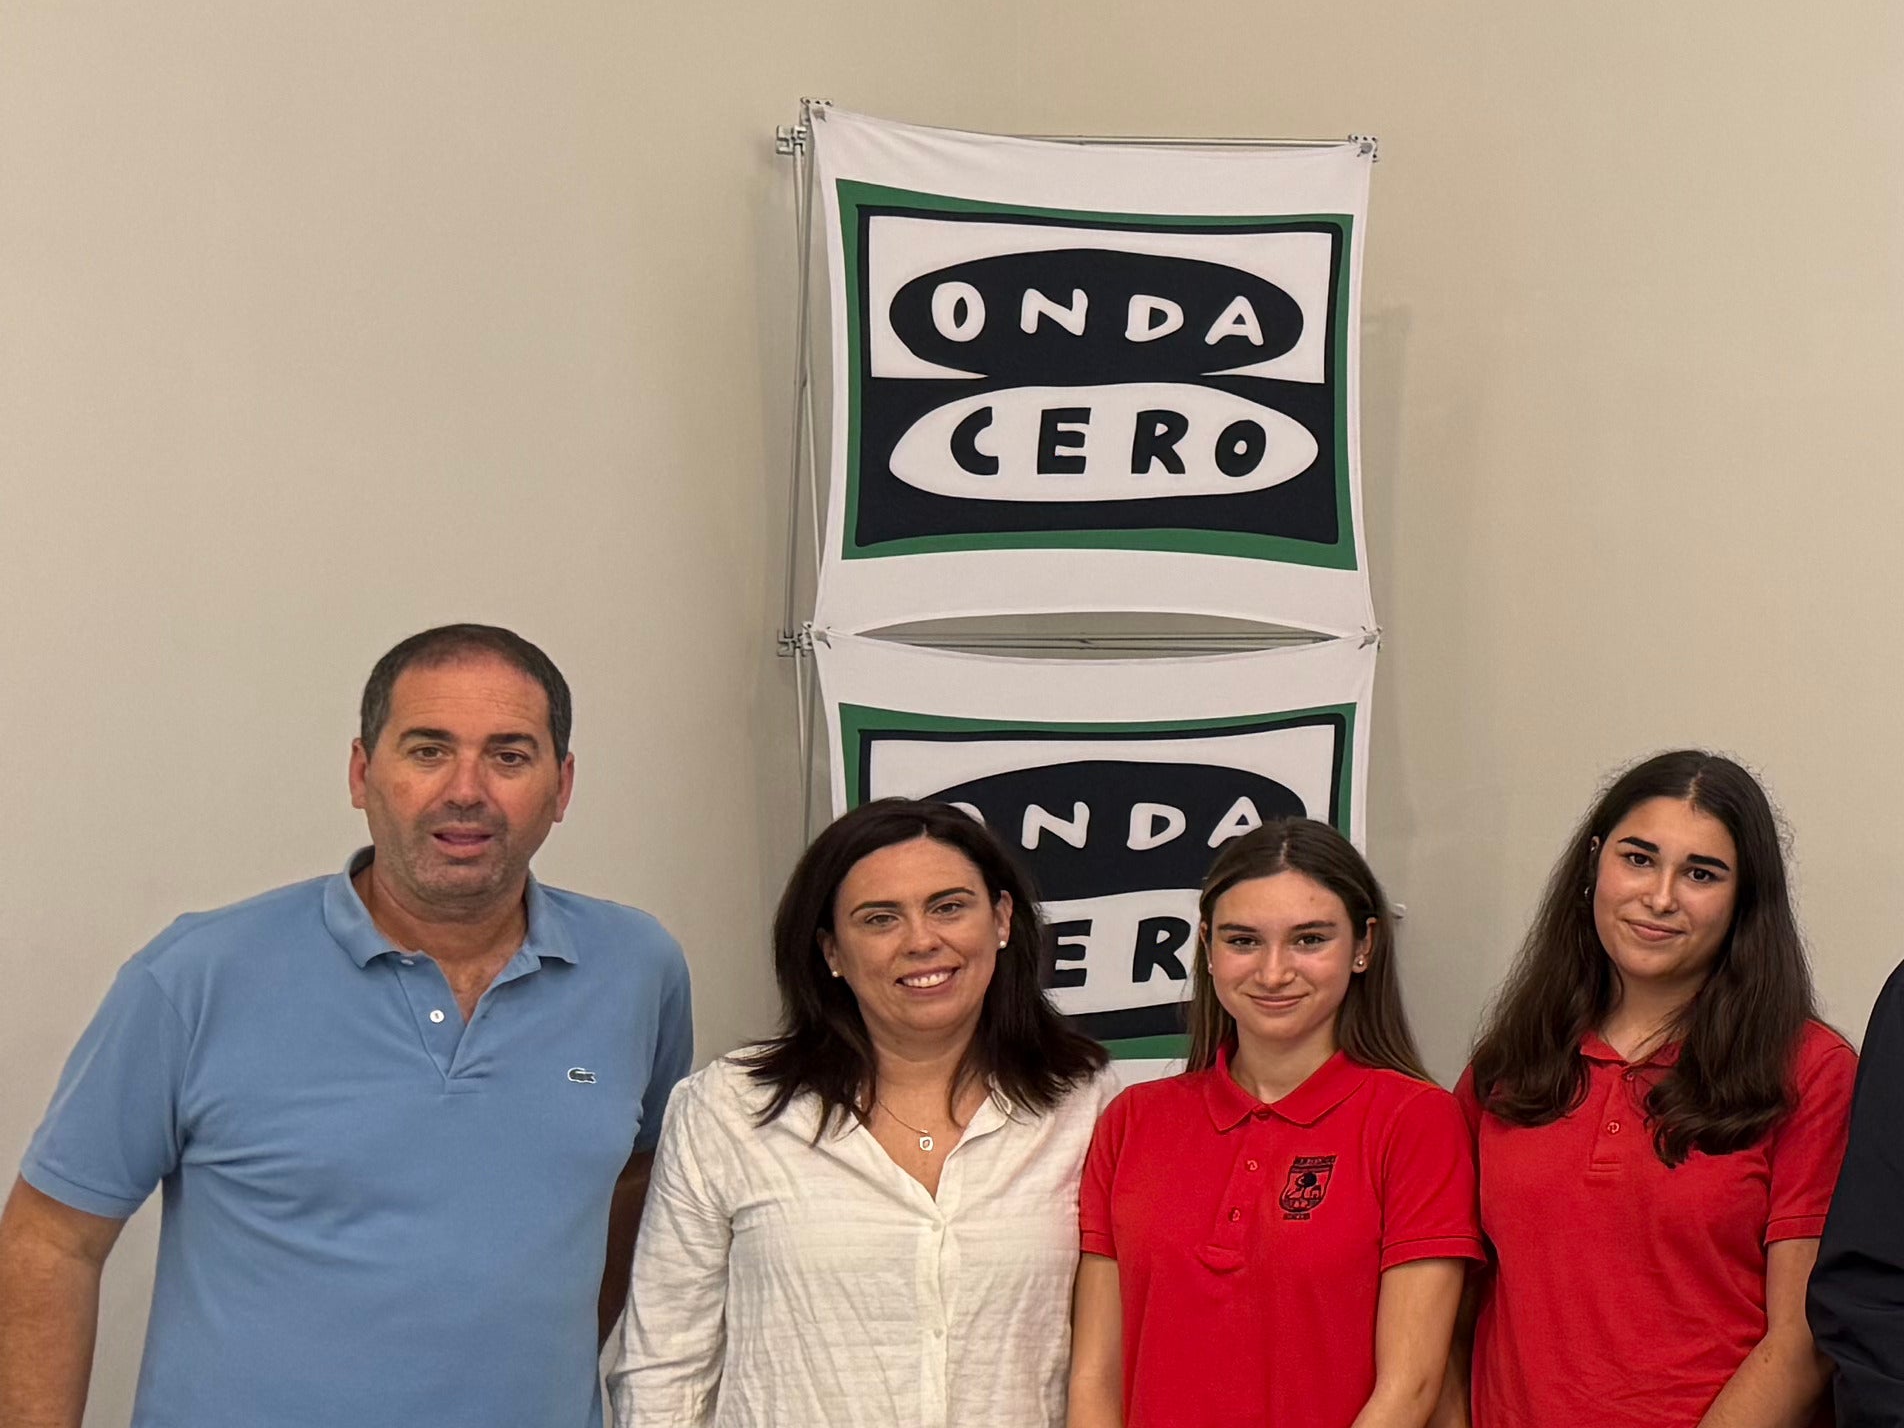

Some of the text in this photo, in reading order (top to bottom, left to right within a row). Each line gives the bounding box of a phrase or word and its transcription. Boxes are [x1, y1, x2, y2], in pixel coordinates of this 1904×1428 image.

[931, 281, 1264, 346] ONDA
[949, 405, 1267, 478] CERO
[950, 795, 1263, 851] NDA
[1043, 915, 1191, 990] ER
